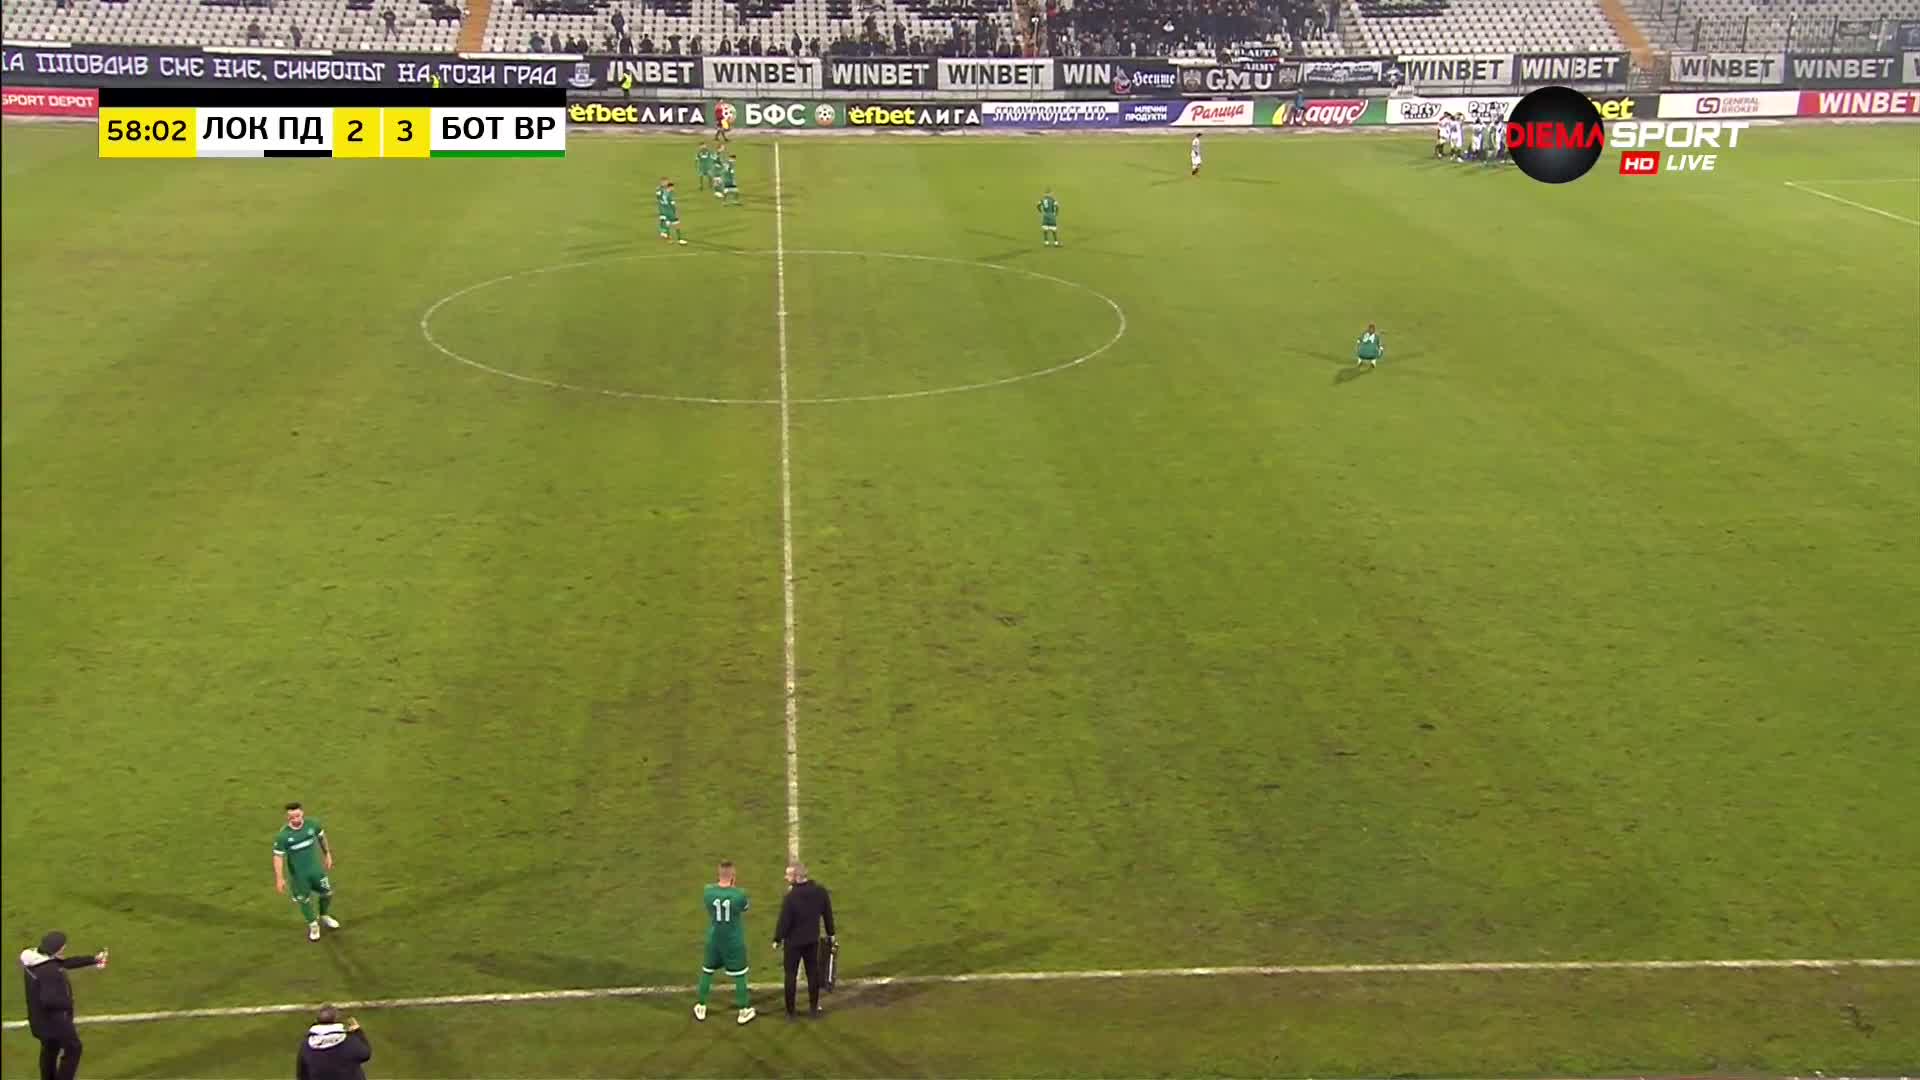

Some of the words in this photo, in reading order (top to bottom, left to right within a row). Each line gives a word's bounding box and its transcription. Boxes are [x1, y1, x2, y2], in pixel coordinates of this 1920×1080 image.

[36, 53, 149, 75] ПЛОВДИВ
[160, 57, 205, 77] СМЕ
[274, 60, 385, 82] СИМВОЛЪТ
[397, 63, 431, 83] НА
[439, 64, 496, 84] ТОЗИ
[503, 65, 557, 85] ГРАД
[713, 62, 812, 84] WINBET
[832, 63, 930, 86] WINBET
[948, 64, 1045, 85] WINBET
[1408, 59, 1504, 81] WINBET
[1522, 57, 1619, 80] WINBET
[1680, 58, 1775, 78] WINBET
[1793, 58, 1895, 79] WINBET
[1206, 68, 1273, 91] GMU
[47, 95, 94, 107] DEPOT
[1401, 102, 1441, 118] Party
[1819, 91, 1920, 114] WINBET
[568, 103, 638, 123] efbet
[640, 107, 705, 124] ЛИГА
[745, 103, 806, 126] БФС
[848, 105, 915, 126] efbet
[917, 108, 981, 126] ЛИГА
[713, 898, 731, 922] 11
